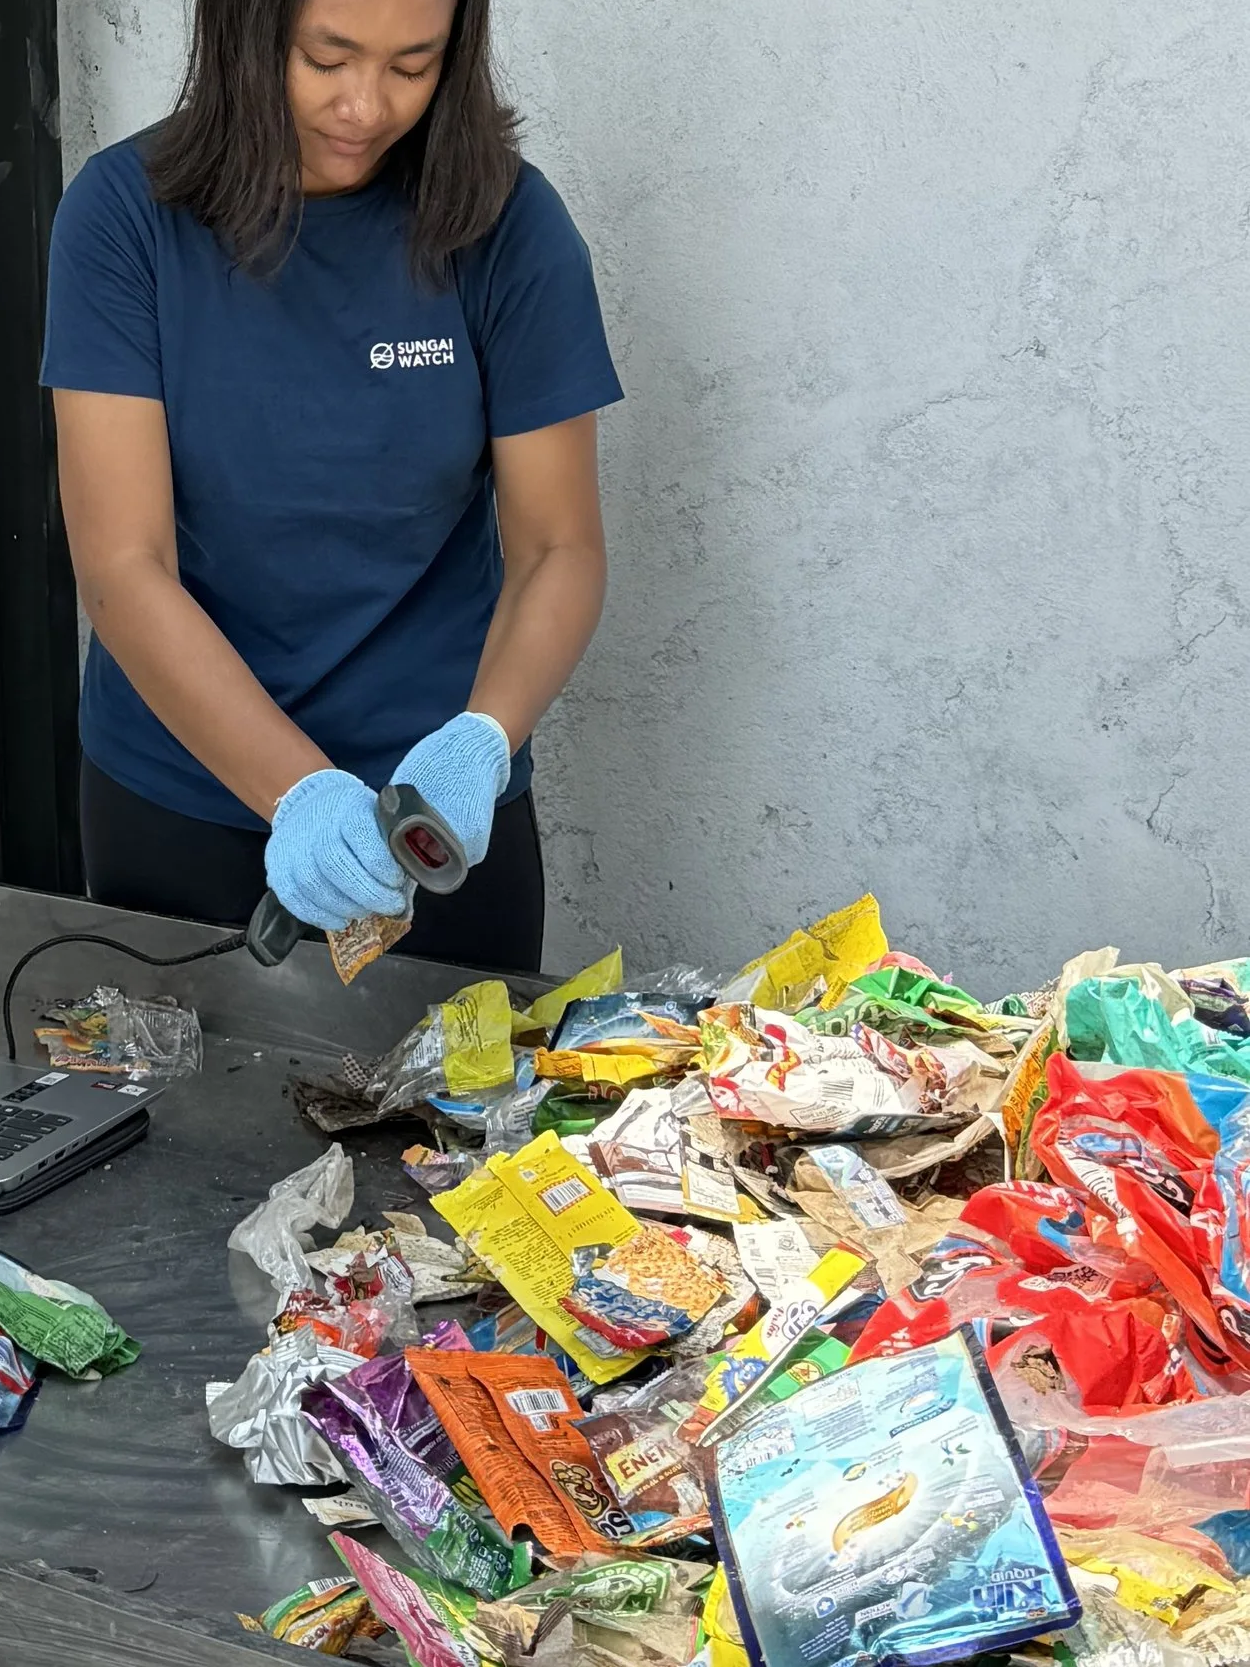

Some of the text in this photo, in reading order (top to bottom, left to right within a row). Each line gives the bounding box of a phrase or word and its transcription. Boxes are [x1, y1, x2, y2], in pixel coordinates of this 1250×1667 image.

[397, 338, 453, 355] SUNGAI
[397, 352, 454, 368] WATCH
[989, 1566, 1036, 1583] LIQUID
